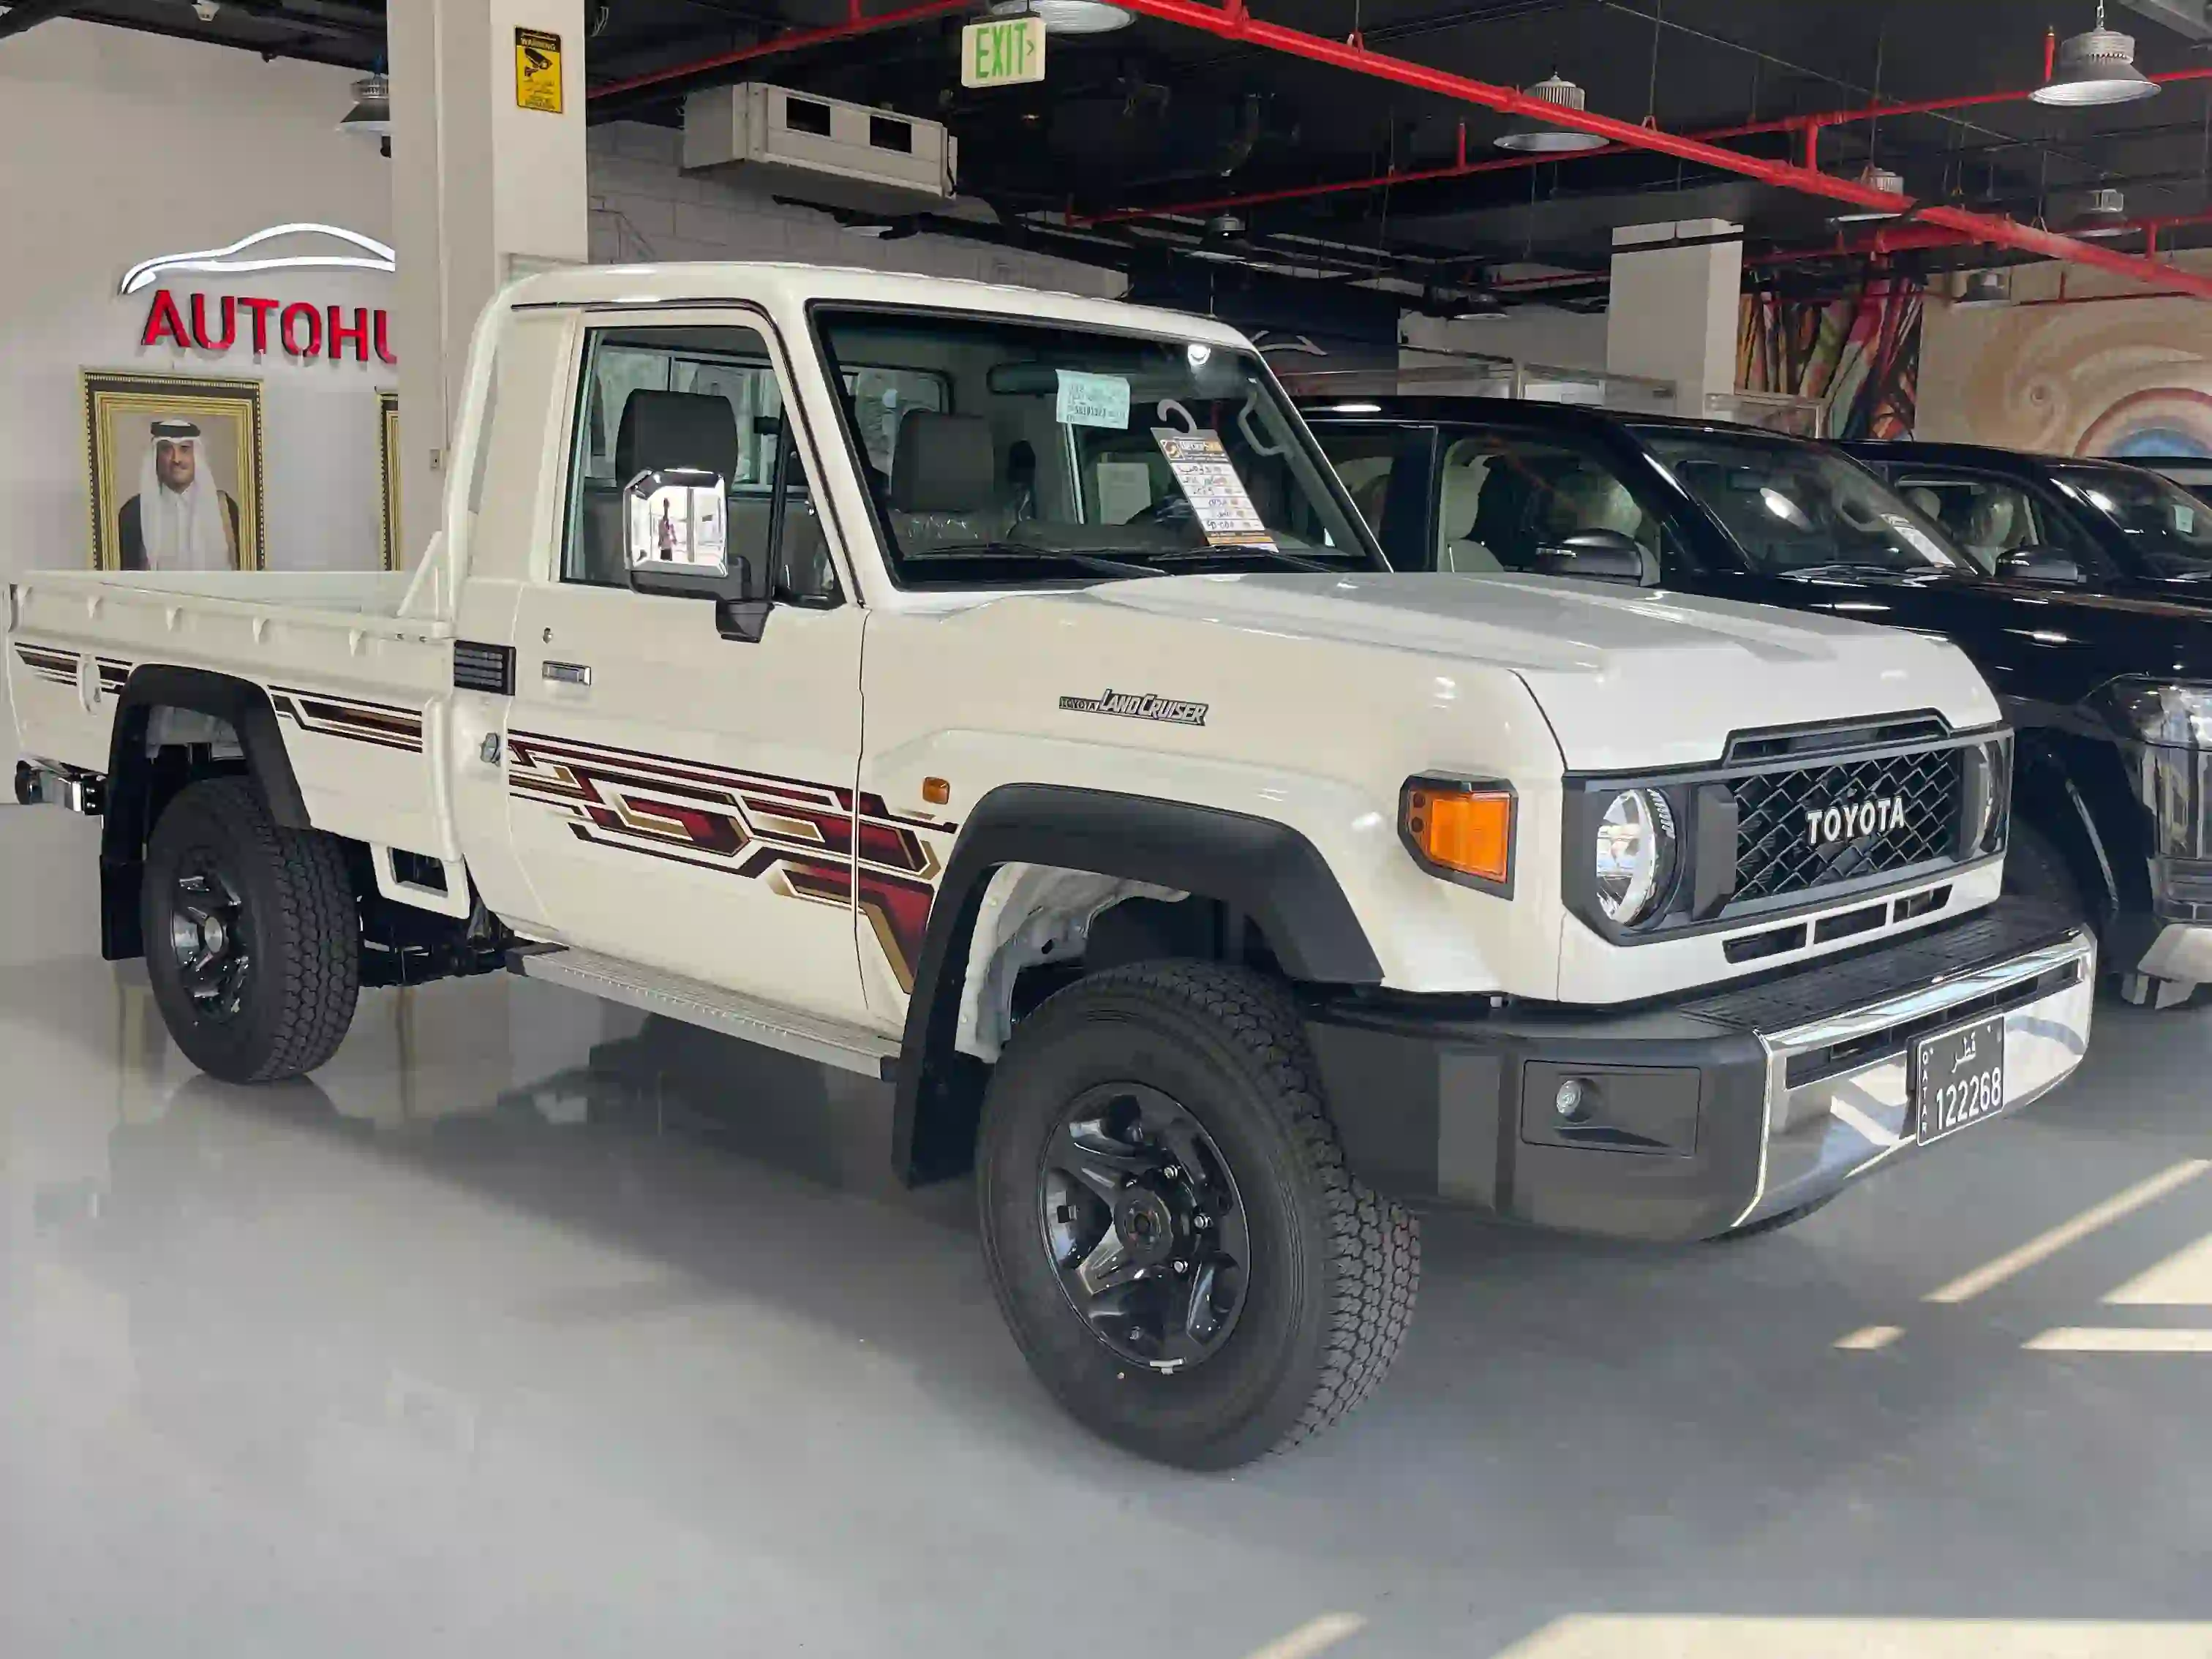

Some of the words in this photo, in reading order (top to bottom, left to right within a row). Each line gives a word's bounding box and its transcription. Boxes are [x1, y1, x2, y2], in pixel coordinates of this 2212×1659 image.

[521, 37, 557, 51] WANG
[976, 23, 1027, 78] EXIT
[1061, 699, 1099, 711] TOYOTA
[1807, 796, 1904, 844] TOYOTA
[1950, 1032, 1976, 1073] قطر
[1936, 1067, 2001, 1129] 122268
